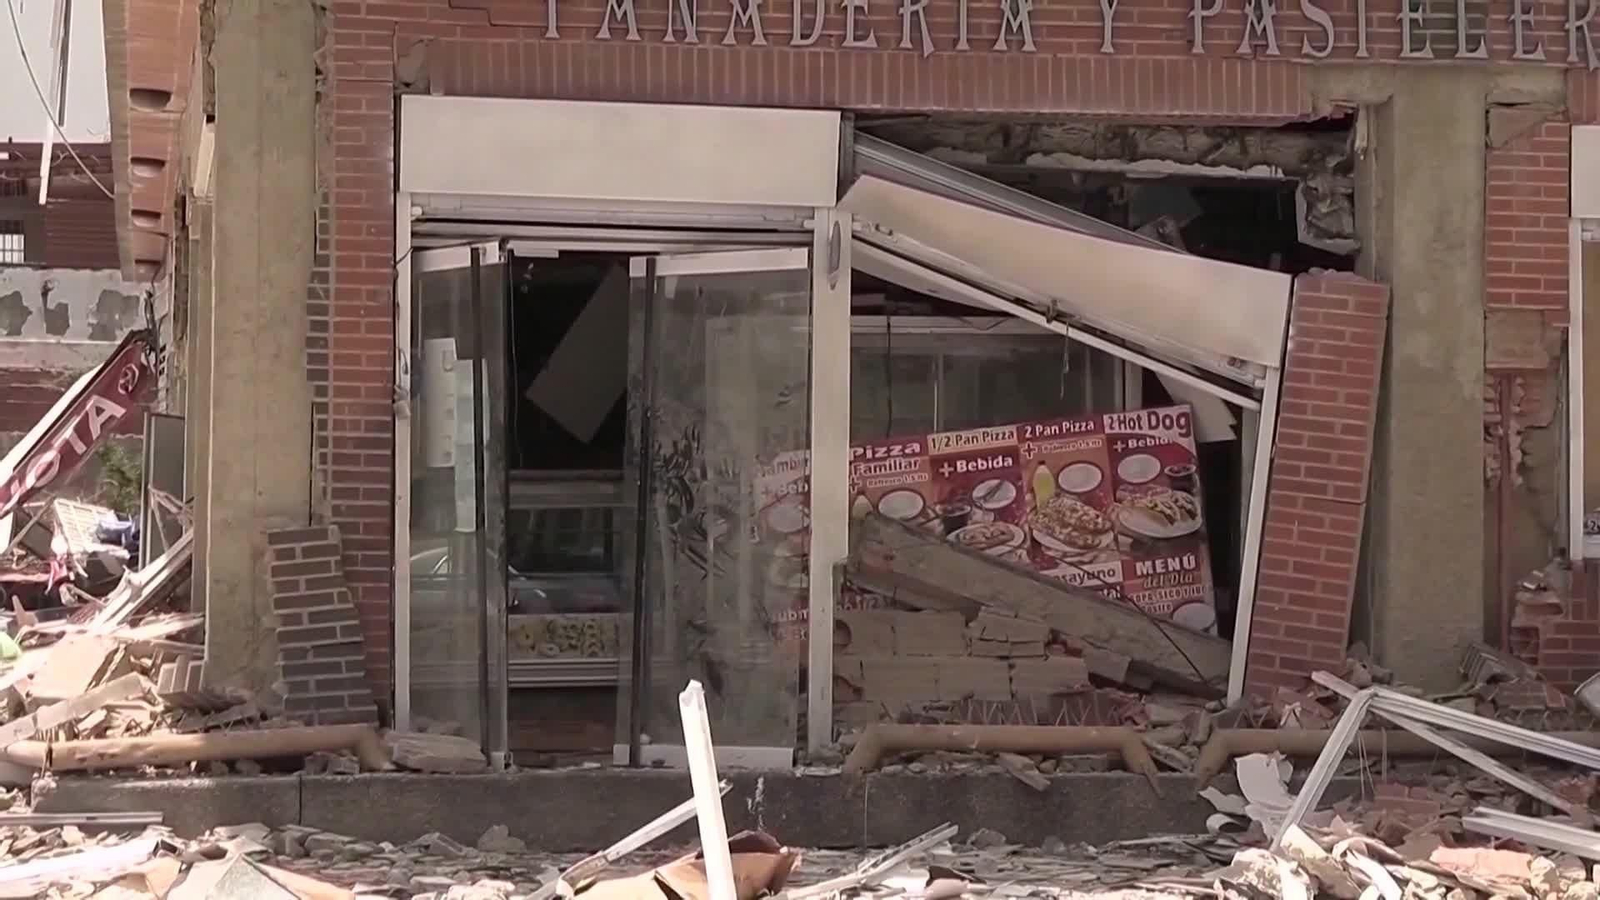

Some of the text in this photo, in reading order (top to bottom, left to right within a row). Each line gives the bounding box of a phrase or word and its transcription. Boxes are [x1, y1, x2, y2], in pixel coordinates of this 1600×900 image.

[1024, 419, 1096, 438] 2 Pan Pizza
[1118, 414, 1144, 431] Hot
[1146, 410, 1192, 439] Dog
[931, 429, 1015, 452] 1/2 Pan Pizza
[850, 441, 921, 461] Pizza
[851, 457, 921, 476] Familiar
[1135, 552, 1197, 576] MENÚ
[1143, 575, 1165, 589] del
